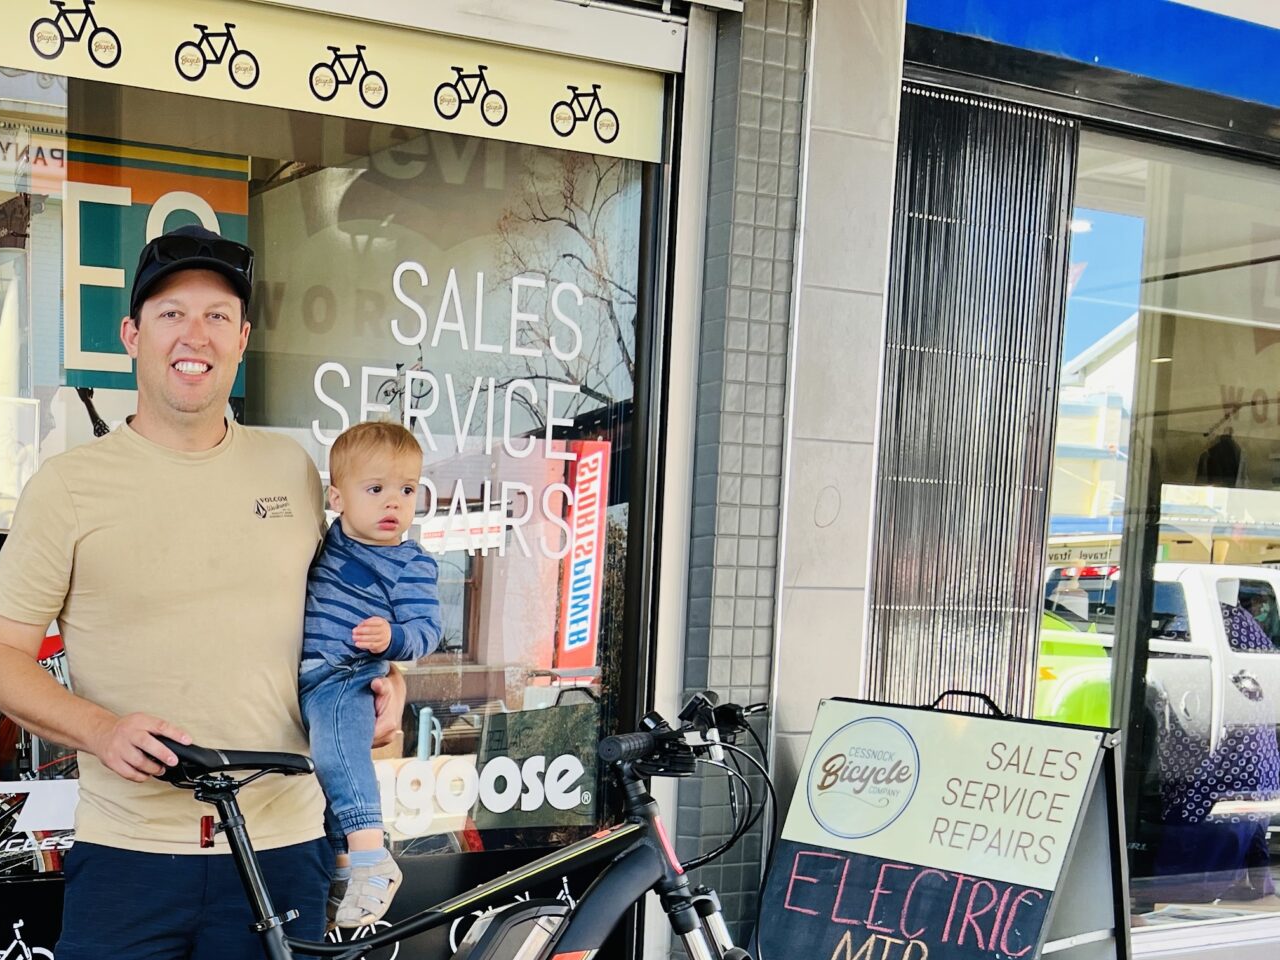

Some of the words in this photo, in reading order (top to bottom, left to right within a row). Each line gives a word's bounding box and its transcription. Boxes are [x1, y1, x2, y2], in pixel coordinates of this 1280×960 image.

[389, 261, 585, 362] SALES
[311, 362, 581, 461] SERVICE
[817, 752, 912, 795] Bicycle
[848, 746, 896, 762] CESSNOCK
[986, 741, 1083, 782] SALES
[867, 784, 902, 799] COMPANY
[941, 776, 1070, 824] SERVICE
[928, 816, 1056, 866] REPAIRS
[784, 850, 1044, 957] ELECTRIC
